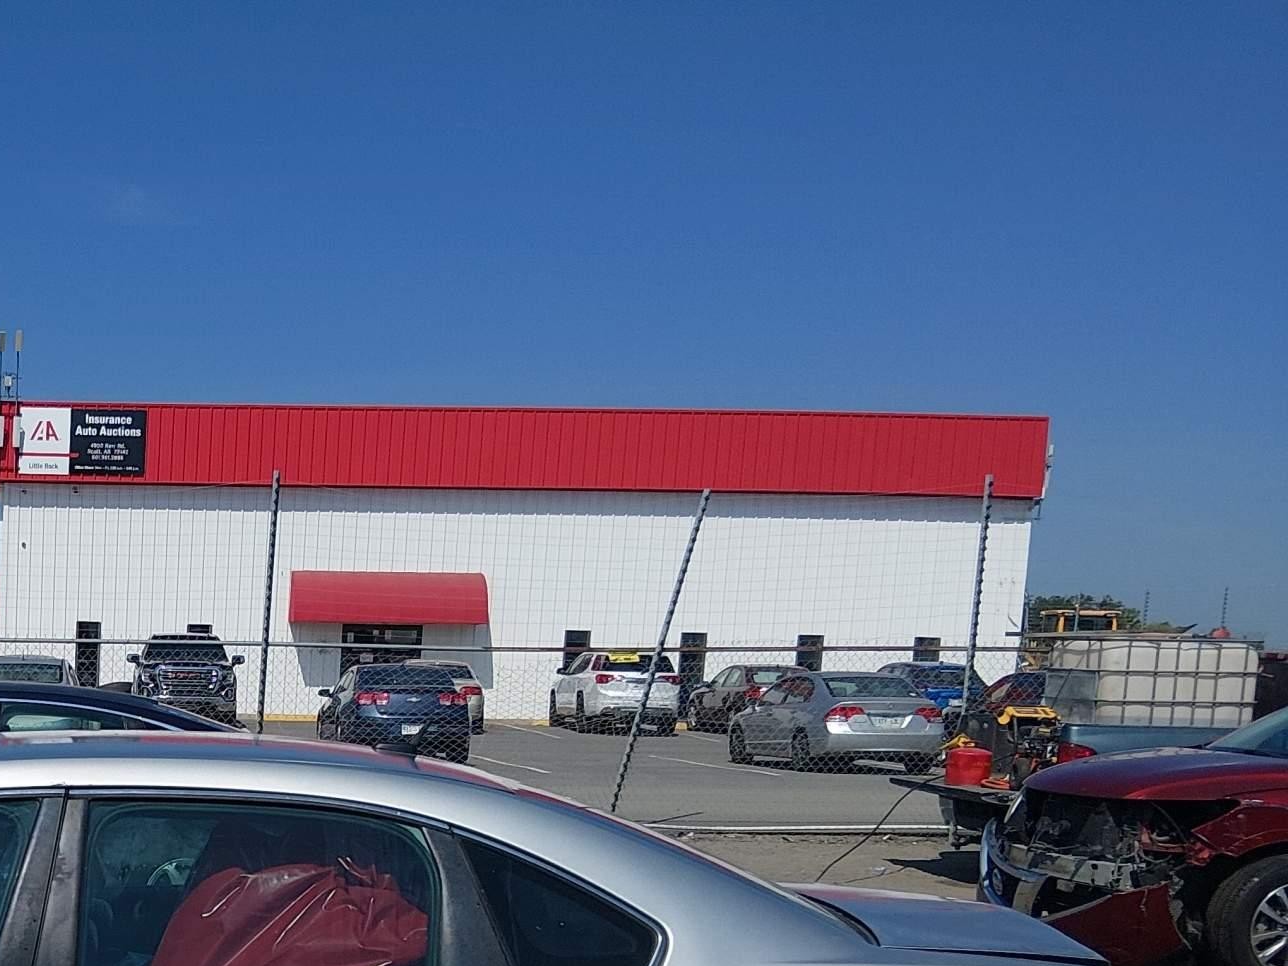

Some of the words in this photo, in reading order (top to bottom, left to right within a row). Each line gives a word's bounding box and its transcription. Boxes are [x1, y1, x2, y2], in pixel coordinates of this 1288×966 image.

[85, 413, 133, 425] Insurance
[75, 425, 97, 436] Auto
[99, 425, 142, 437] Auctions
